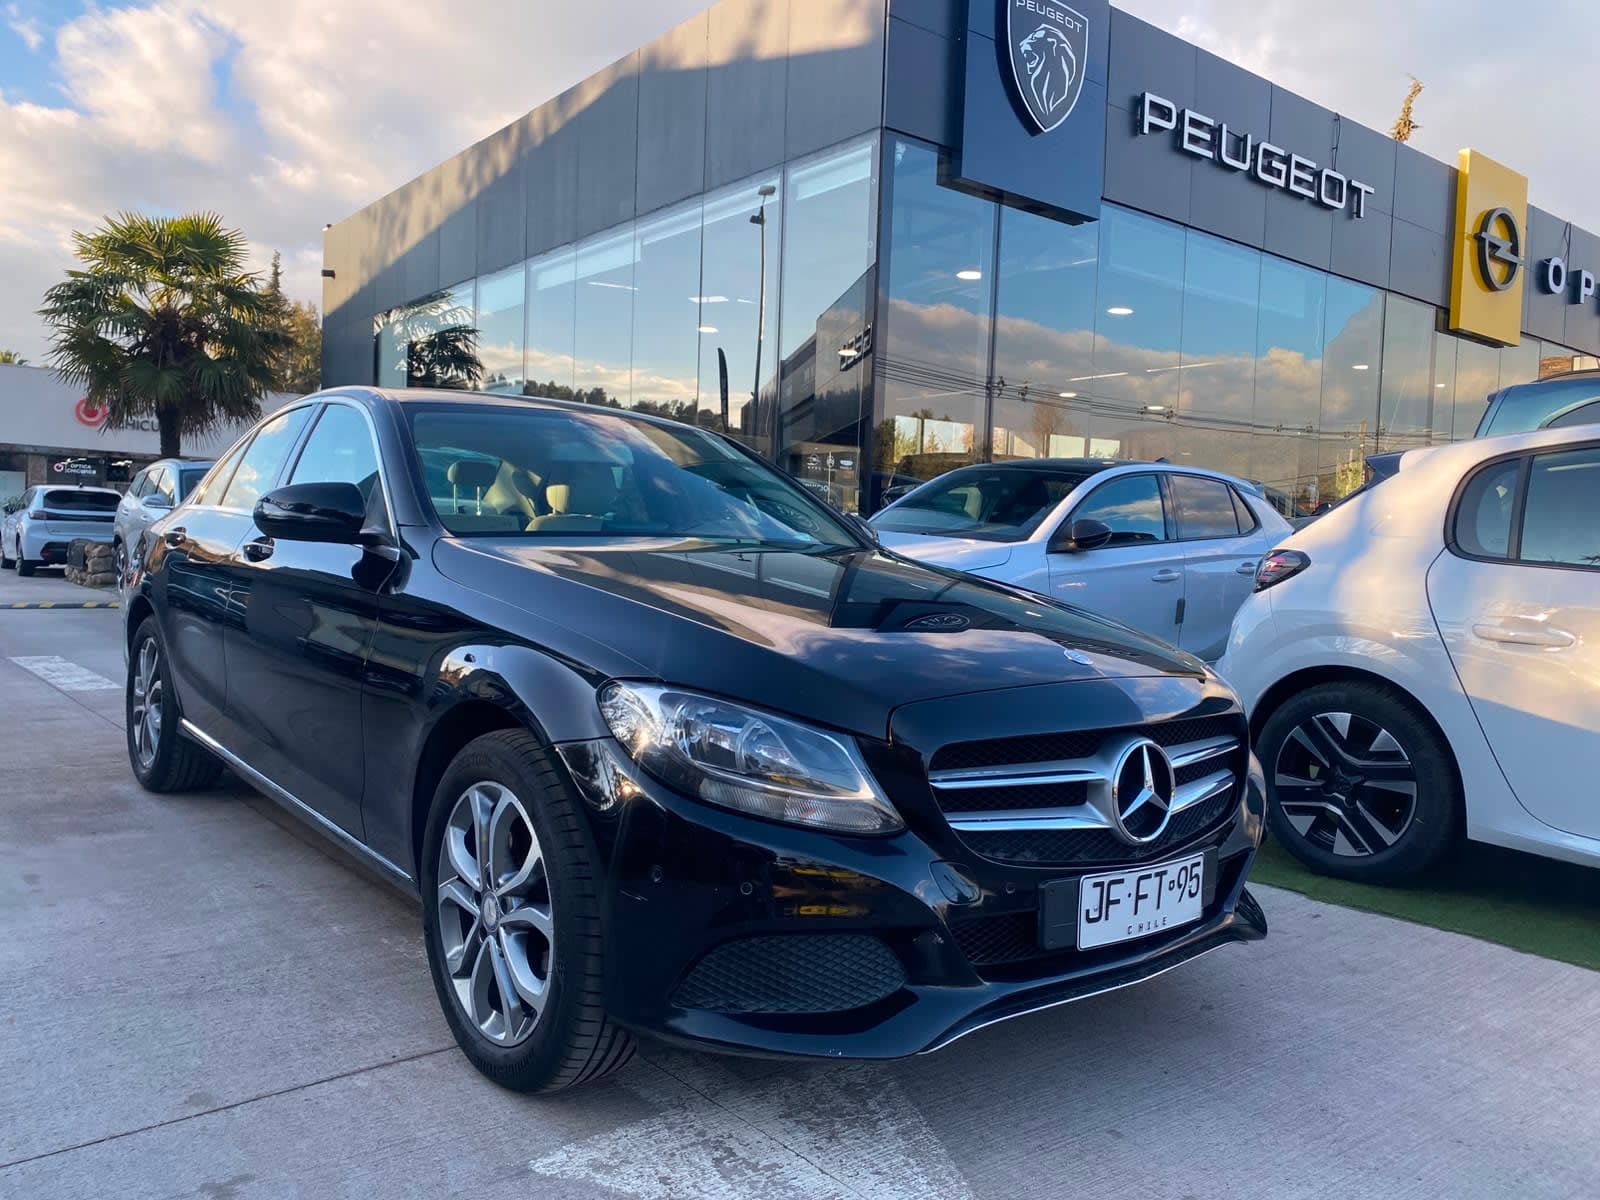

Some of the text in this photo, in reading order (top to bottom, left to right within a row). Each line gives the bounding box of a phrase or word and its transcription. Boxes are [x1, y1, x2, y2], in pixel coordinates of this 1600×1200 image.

[1016, 0, 1082, 33] PEUGEOT
[1143, 91, 1375, 218] PEUGEOT
[1547, 256, 1600, 305] OP
[1126, 916, 1168, 935] CHILE
